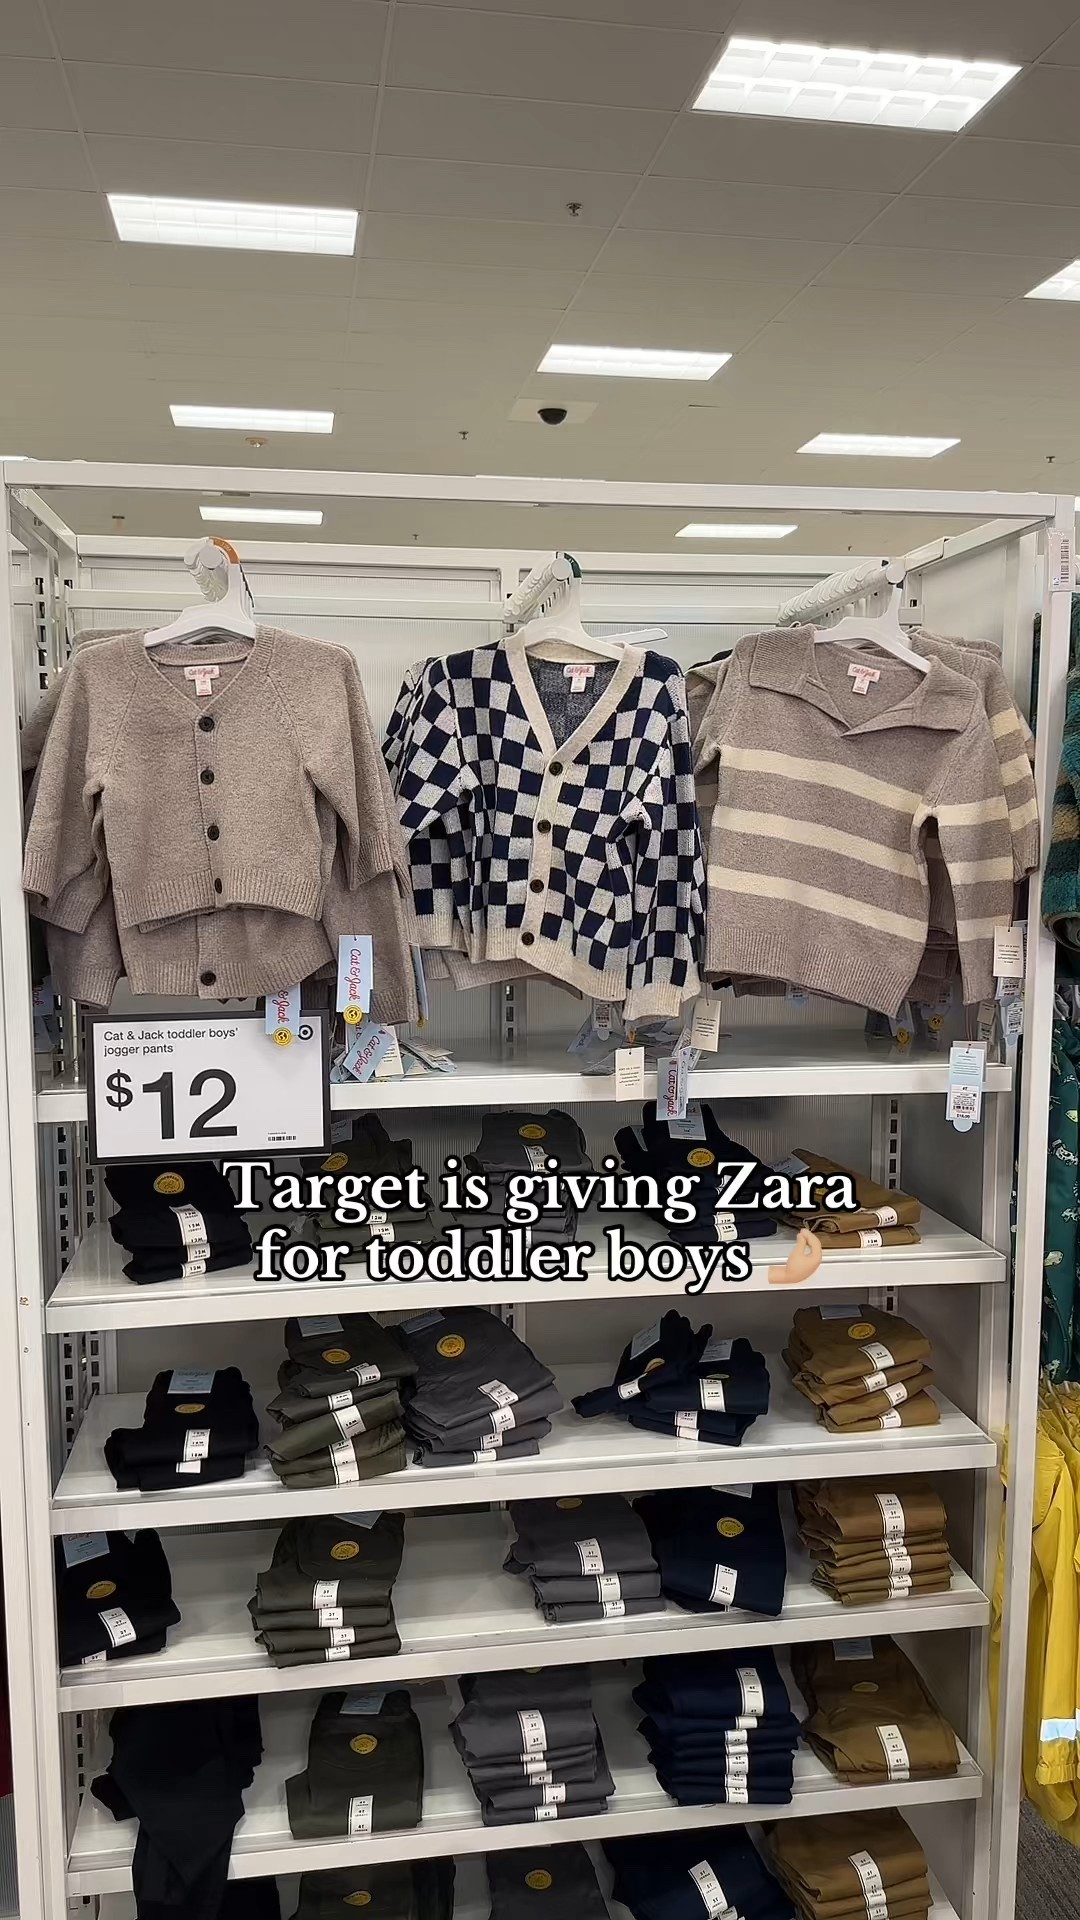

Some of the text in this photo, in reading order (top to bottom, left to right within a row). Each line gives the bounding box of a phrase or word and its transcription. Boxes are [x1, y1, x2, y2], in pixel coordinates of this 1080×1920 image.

[344, 948, 362, 1002] Cat & Jack
[272, 990, 290, 1024] & Jack
[103, 1027, 239, 1041] Cat & Jack toddler boys'
[366, 1035, 381, 1050] Cat
[104, 1044, 174, 1057] jogger pants
[363, 1047, 373, 1058] &
[351, 1052, 368, 1075] Jack
[106, 1069, 237, 1139] $12
